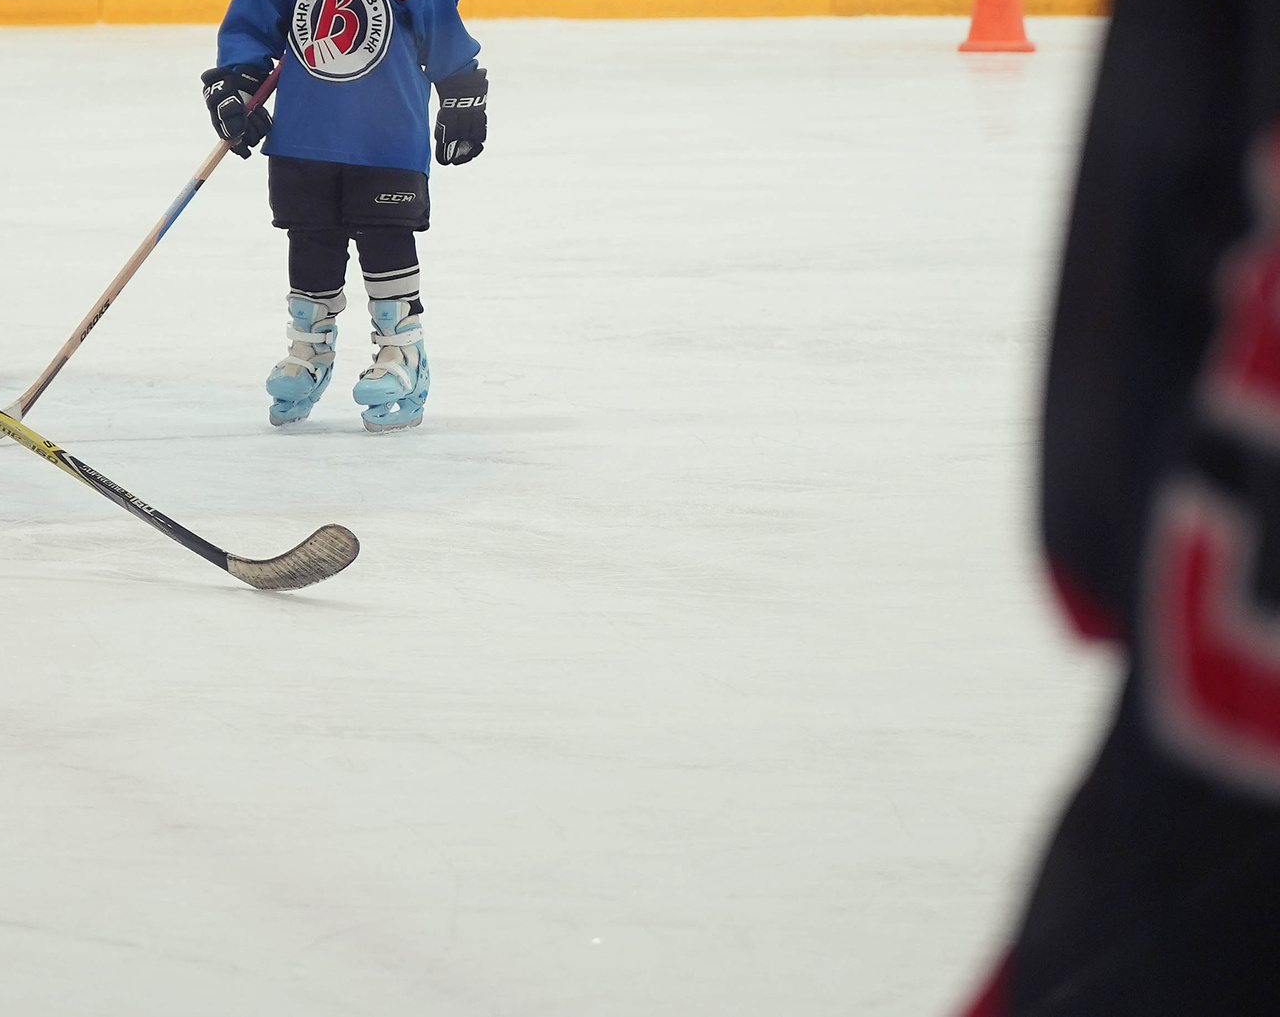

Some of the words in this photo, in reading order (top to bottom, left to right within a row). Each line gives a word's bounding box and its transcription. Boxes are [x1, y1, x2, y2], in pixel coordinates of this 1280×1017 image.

[296, 2, 310, 46] VIKHR
[363, 13, 383, 54] VIKHR
[379, 192, 414, 203] CCM
